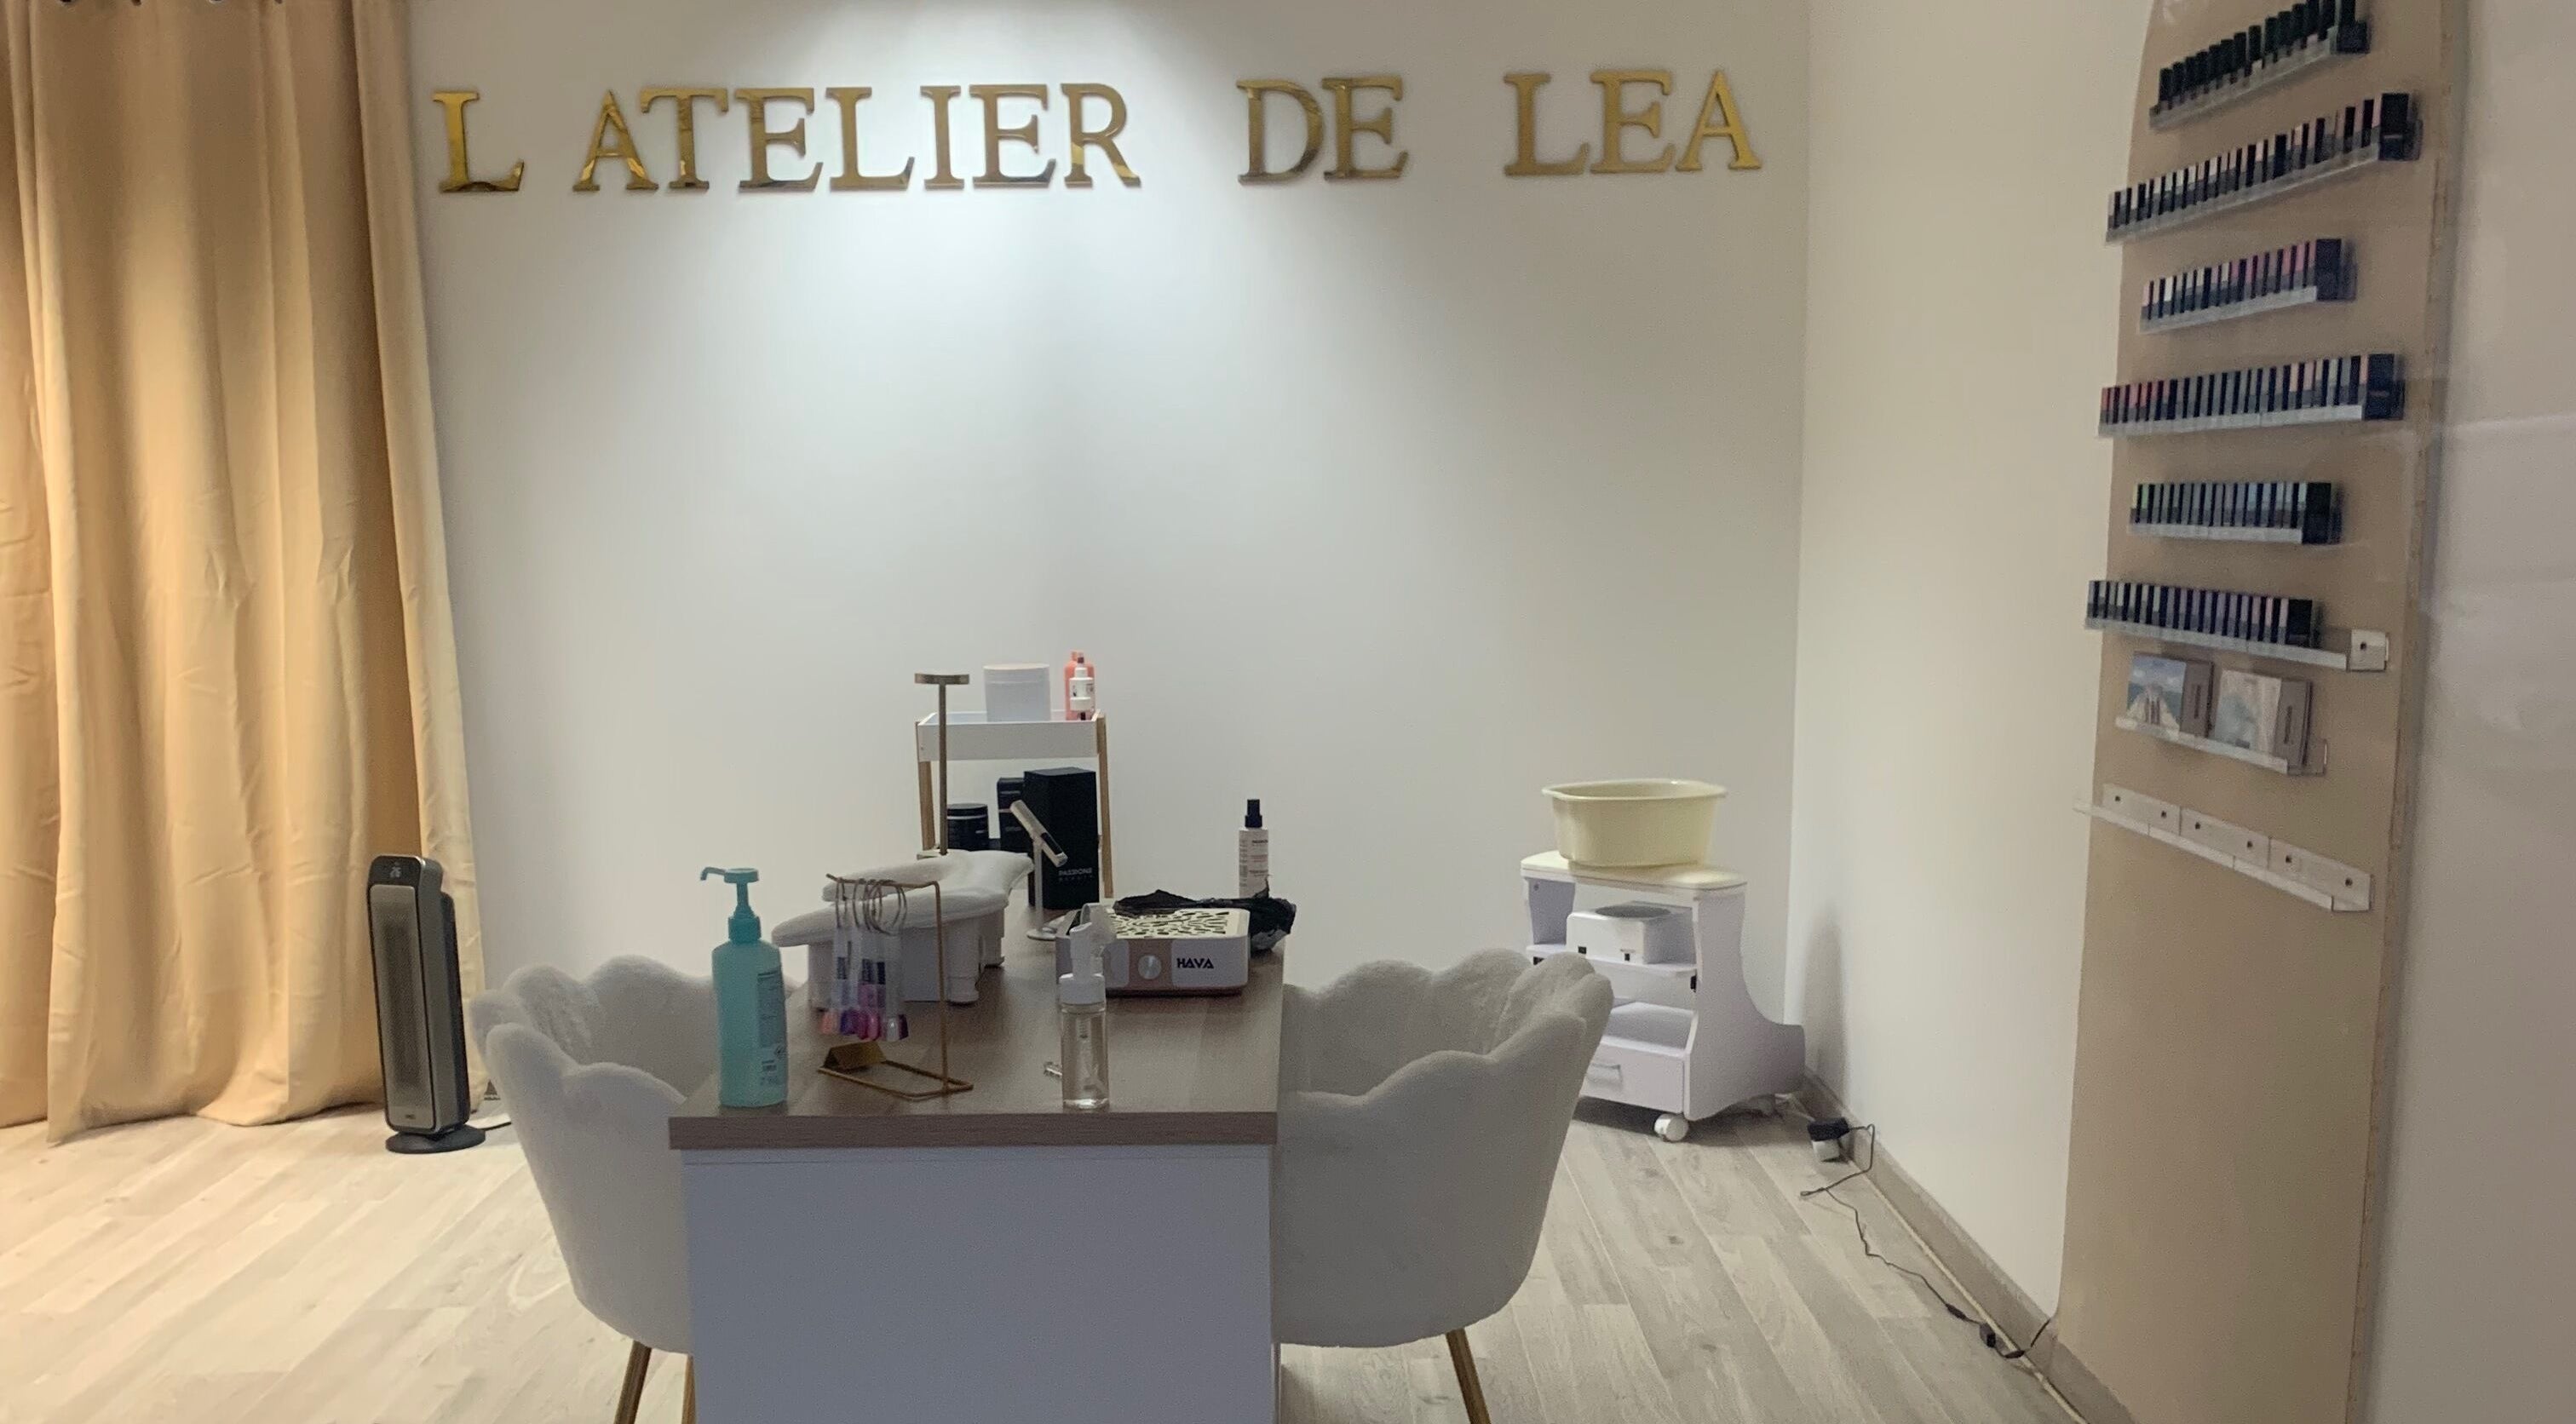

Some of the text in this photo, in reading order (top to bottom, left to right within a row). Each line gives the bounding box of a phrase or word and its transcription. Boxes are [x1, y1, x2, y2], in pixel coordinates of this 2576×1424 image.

[431, 67, 1763, 194] L ATELIER DE LEA
[1176, 957, 1214, 969] HAVA
